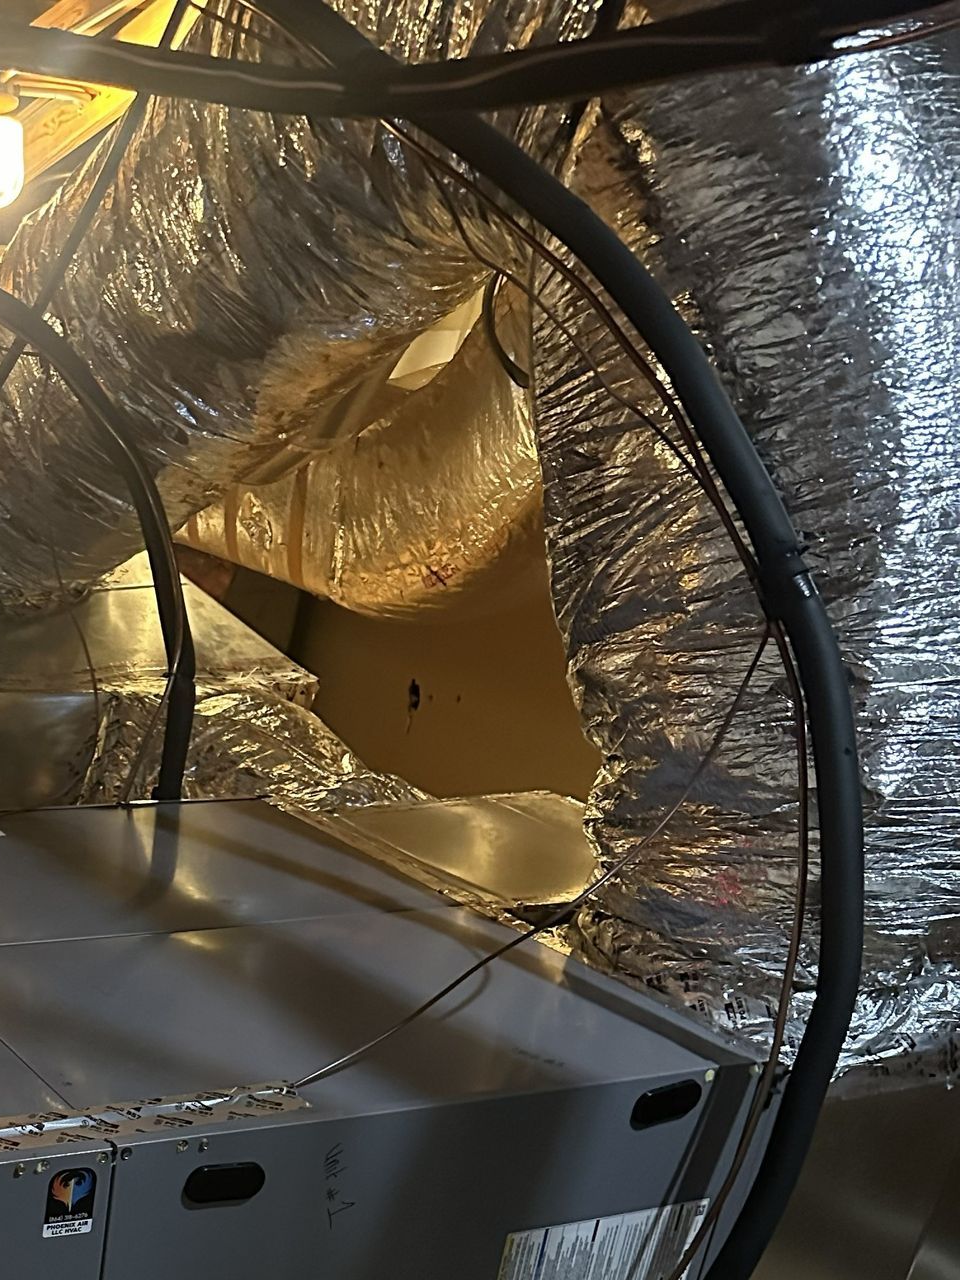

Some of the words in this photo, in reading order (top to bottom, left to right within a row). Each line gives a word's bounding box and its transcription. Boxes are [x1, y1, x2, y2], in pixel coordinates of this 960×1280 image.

[46, 1222, 76, 1231] PHOENIX
[77, 1220, 89, 1228] AIR
[65, 1226, 82, 1234] HVAC
